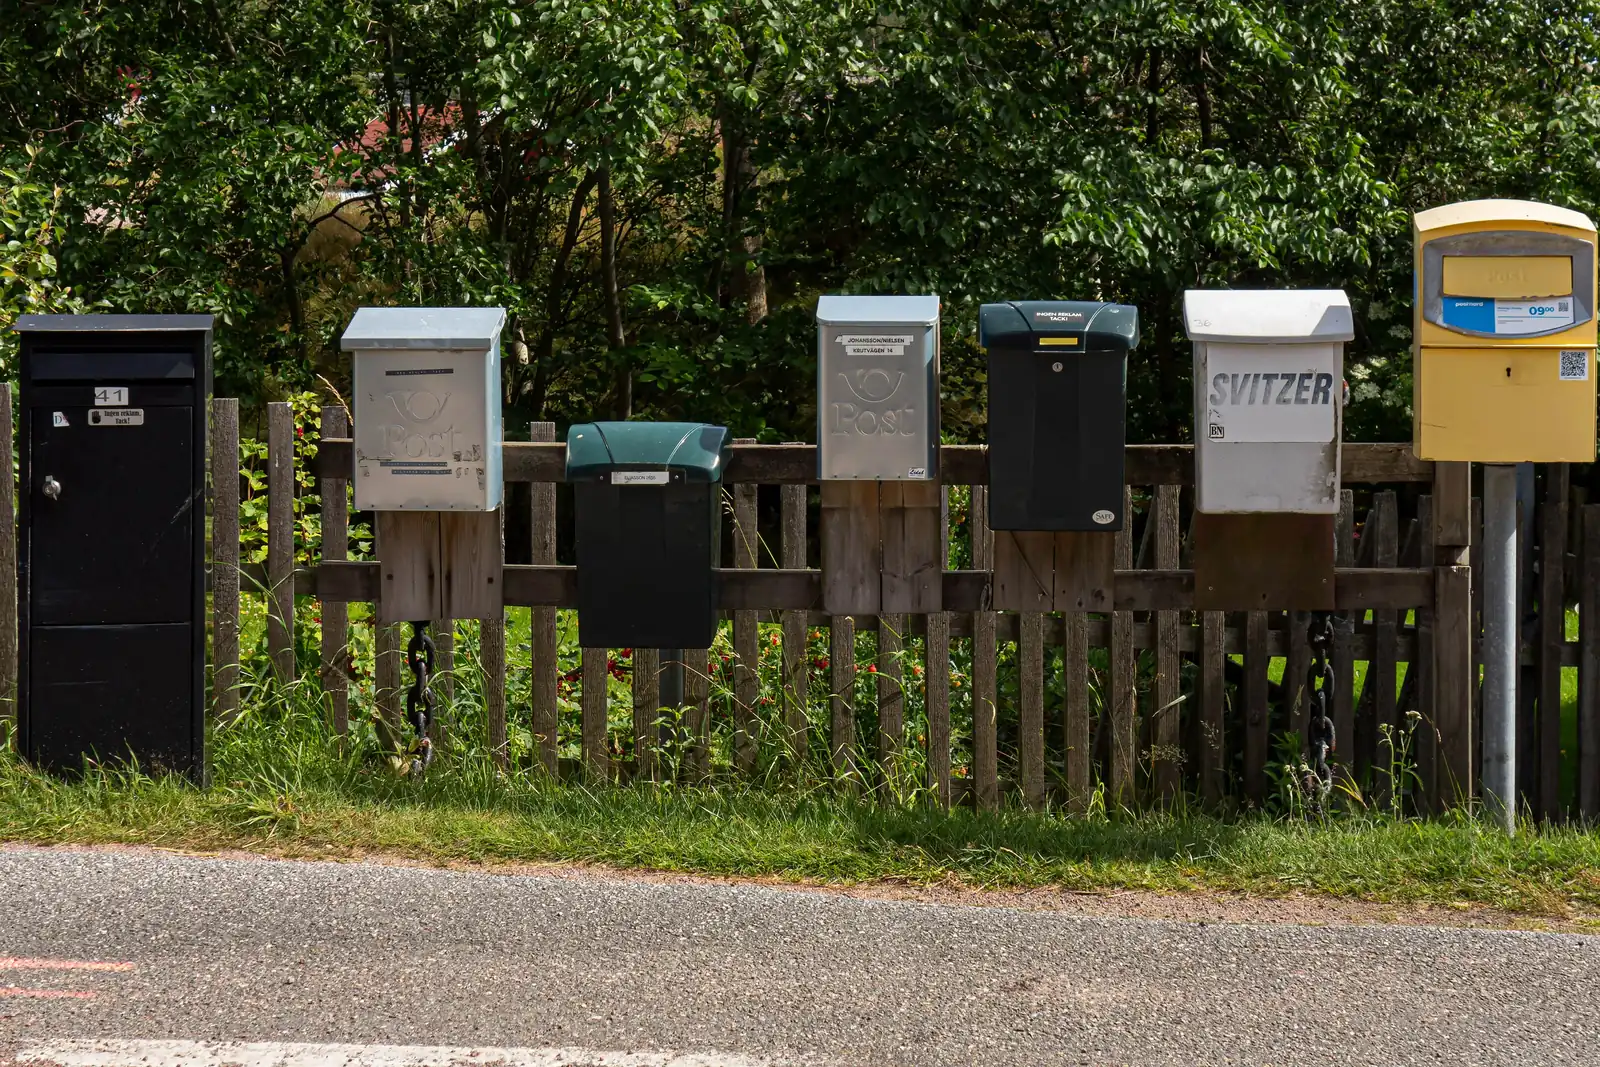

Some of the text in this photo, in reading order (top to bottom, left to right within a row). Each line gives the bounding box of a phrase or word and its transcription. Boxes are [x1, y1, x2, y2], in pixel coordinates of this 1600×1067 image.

[95, 389, 122, 402] 41
[1209, 373, 1333, 406] SVITZER
[831, 402, 916, 437] Post
[1211, 426, 1223, 435] BN
